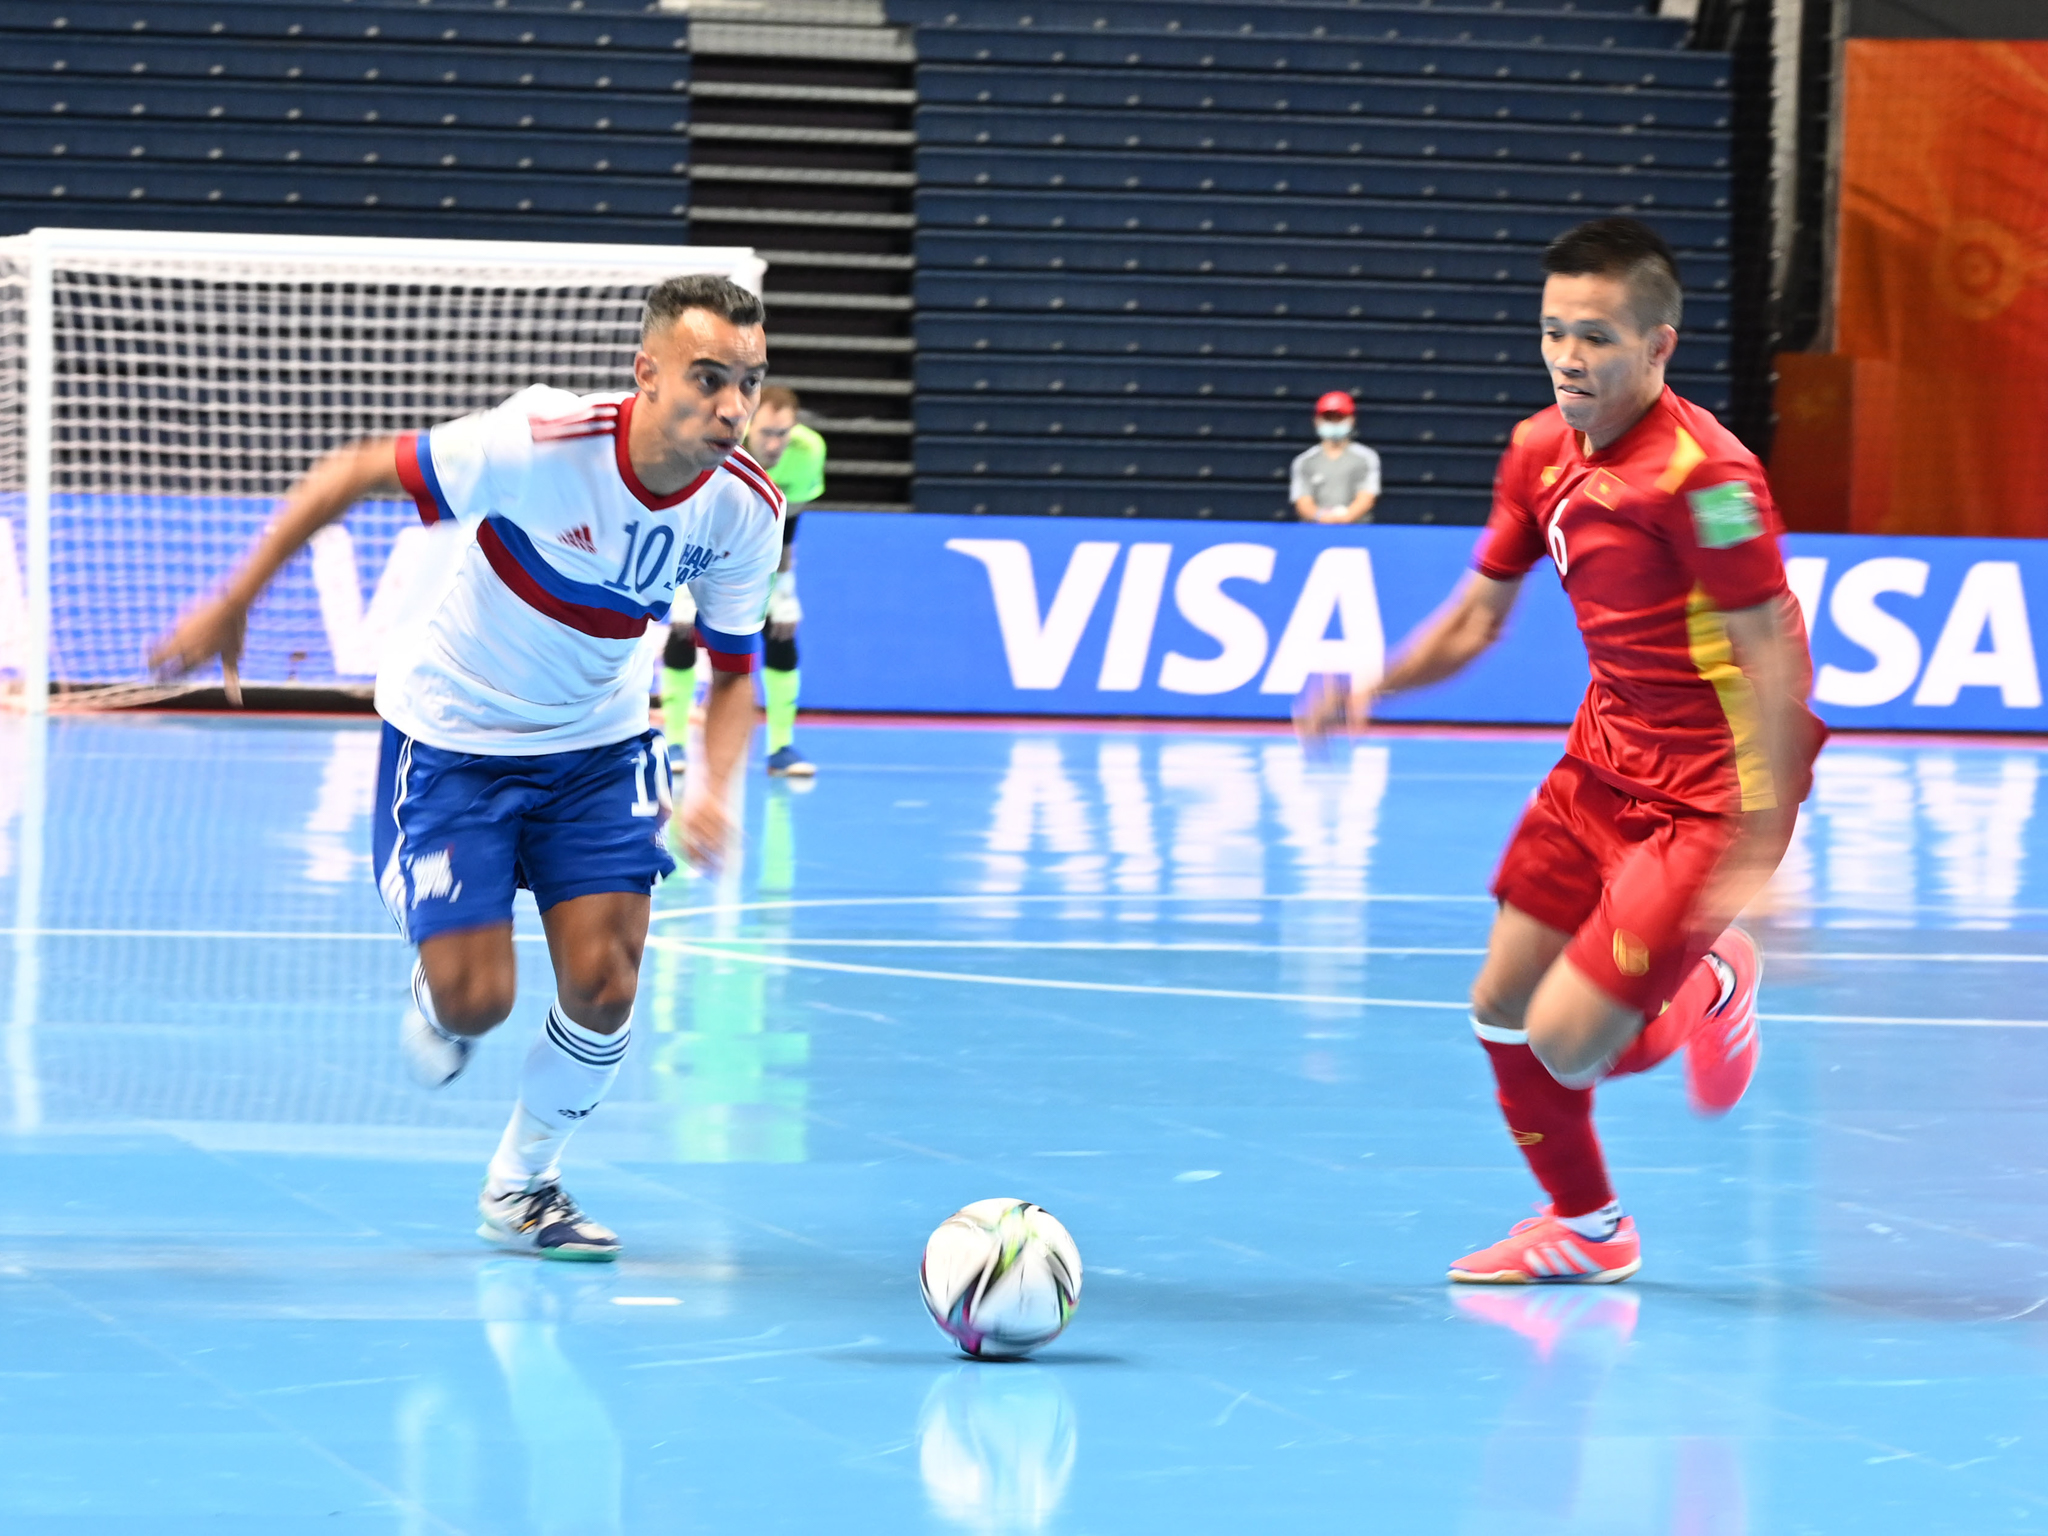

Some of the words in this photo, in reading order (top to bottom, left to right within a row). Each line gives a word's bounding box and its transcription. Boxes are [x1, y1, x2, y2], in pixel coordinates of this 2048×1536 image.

[603, 519, 675, 595] 10
[1547, 498, 1569, 577] 6
[943, 537, 1386, 696] VISA
[1786, 556, 2043, 709] SA
